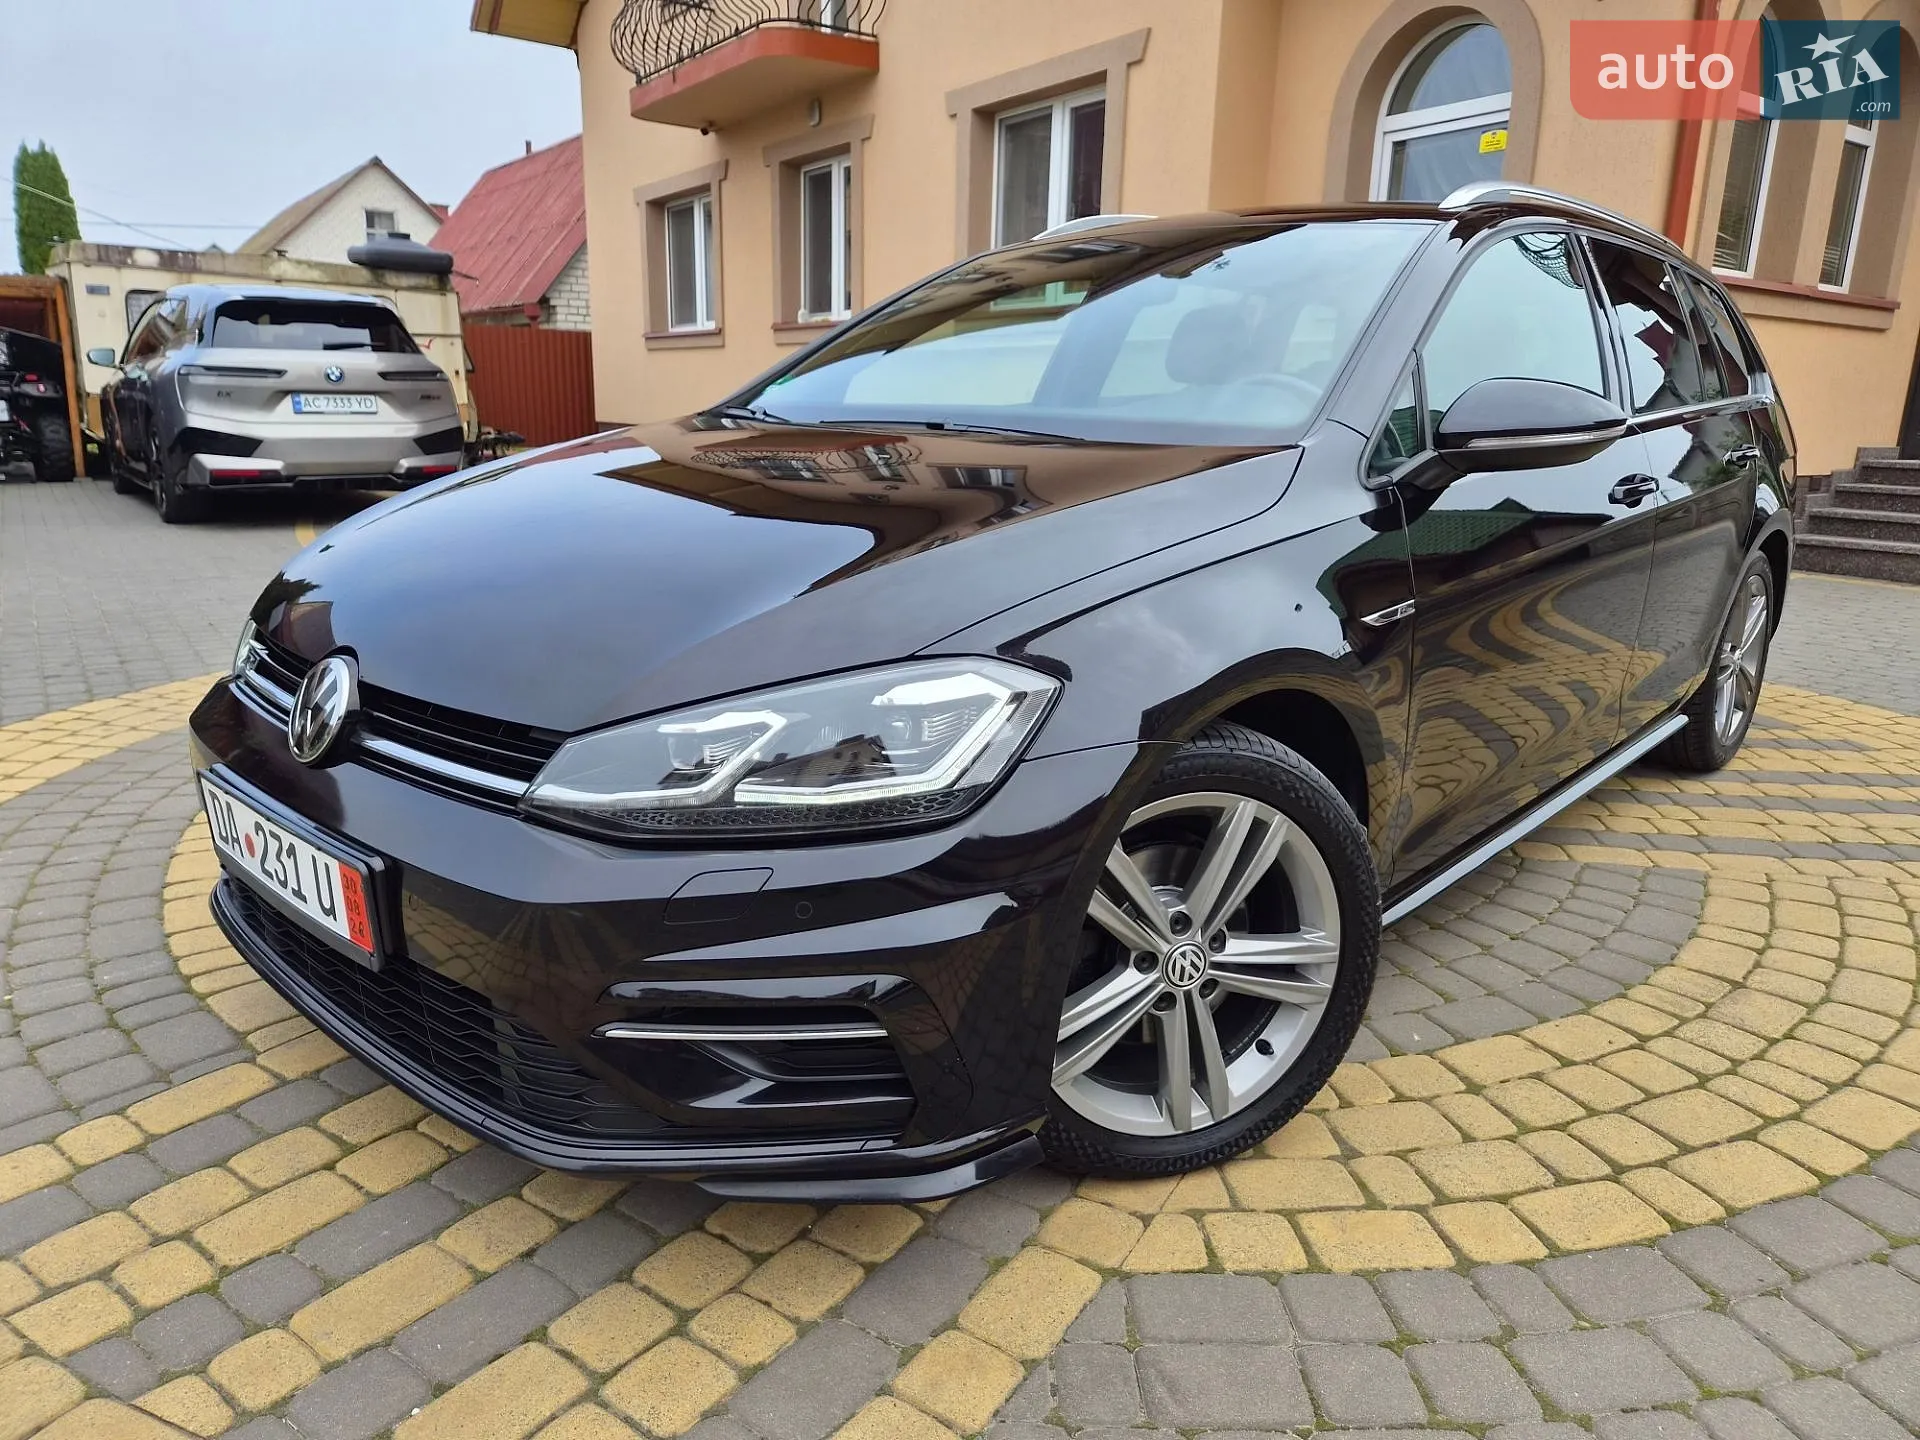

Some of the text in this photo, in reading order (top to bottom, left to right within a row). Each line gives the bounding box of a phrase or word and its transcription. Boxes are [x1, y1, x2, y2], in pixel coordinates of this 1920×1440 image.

[303, 396, 374, 409] AC 7333 YD
[207, 788, 338, 923] DA 231 U
